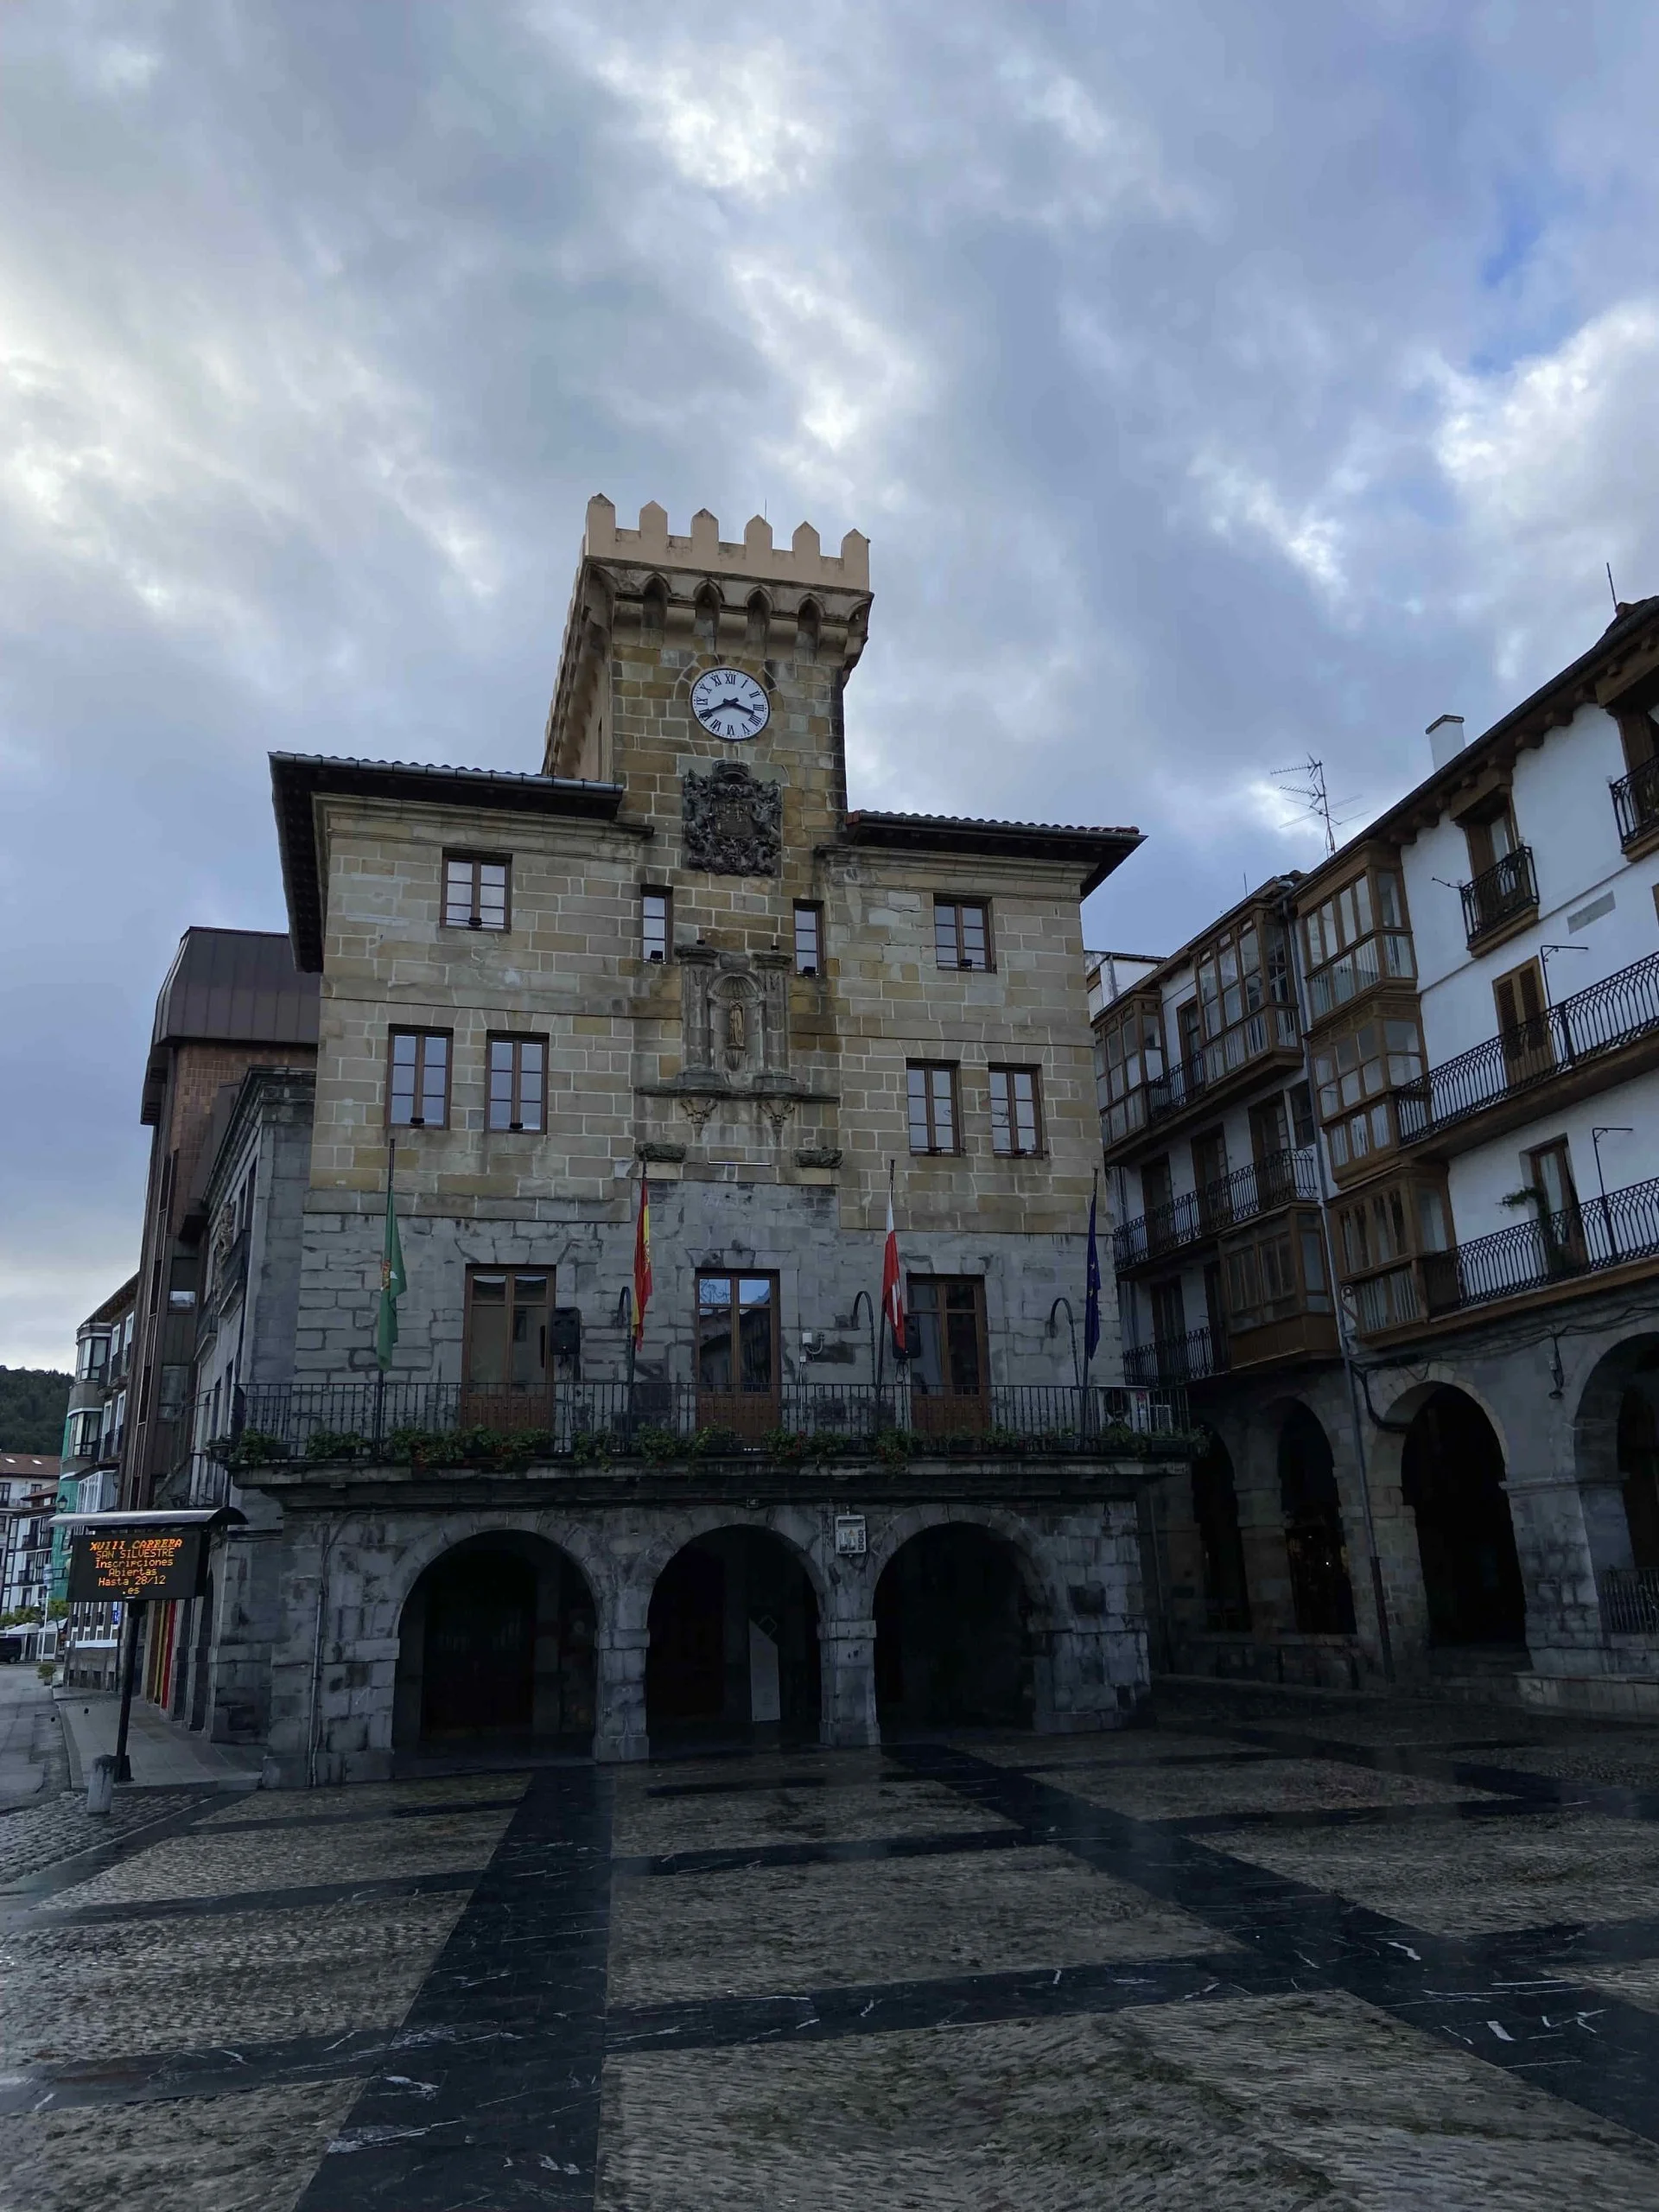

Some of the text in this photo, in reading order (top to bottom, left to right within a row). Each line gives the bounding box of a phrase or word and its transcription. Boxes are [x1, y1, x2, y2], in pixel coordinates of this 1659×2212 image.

[711, 675, 722, 687] XI
[725, 674, 736, 685] XII
[741, 680, 748, 689] I
[700, 685, 712, 694] X
[696, 696, 708, 705] IX
[710, 719, 721, 732] VII
[728, 725, 734, 735] VI
[741, 723, 750, 734] V
[131, 1538, 183, 1549] CARRERA
[95, 1550, 115, 1560] SAN
[95, 1558, 174, 1569] Inscripciones
[108, 1567, 157, 1577] Abiertas
[98, 1574, 167, 1586] Hasta 28/12
[122, 1586, 141, 1595] .es
